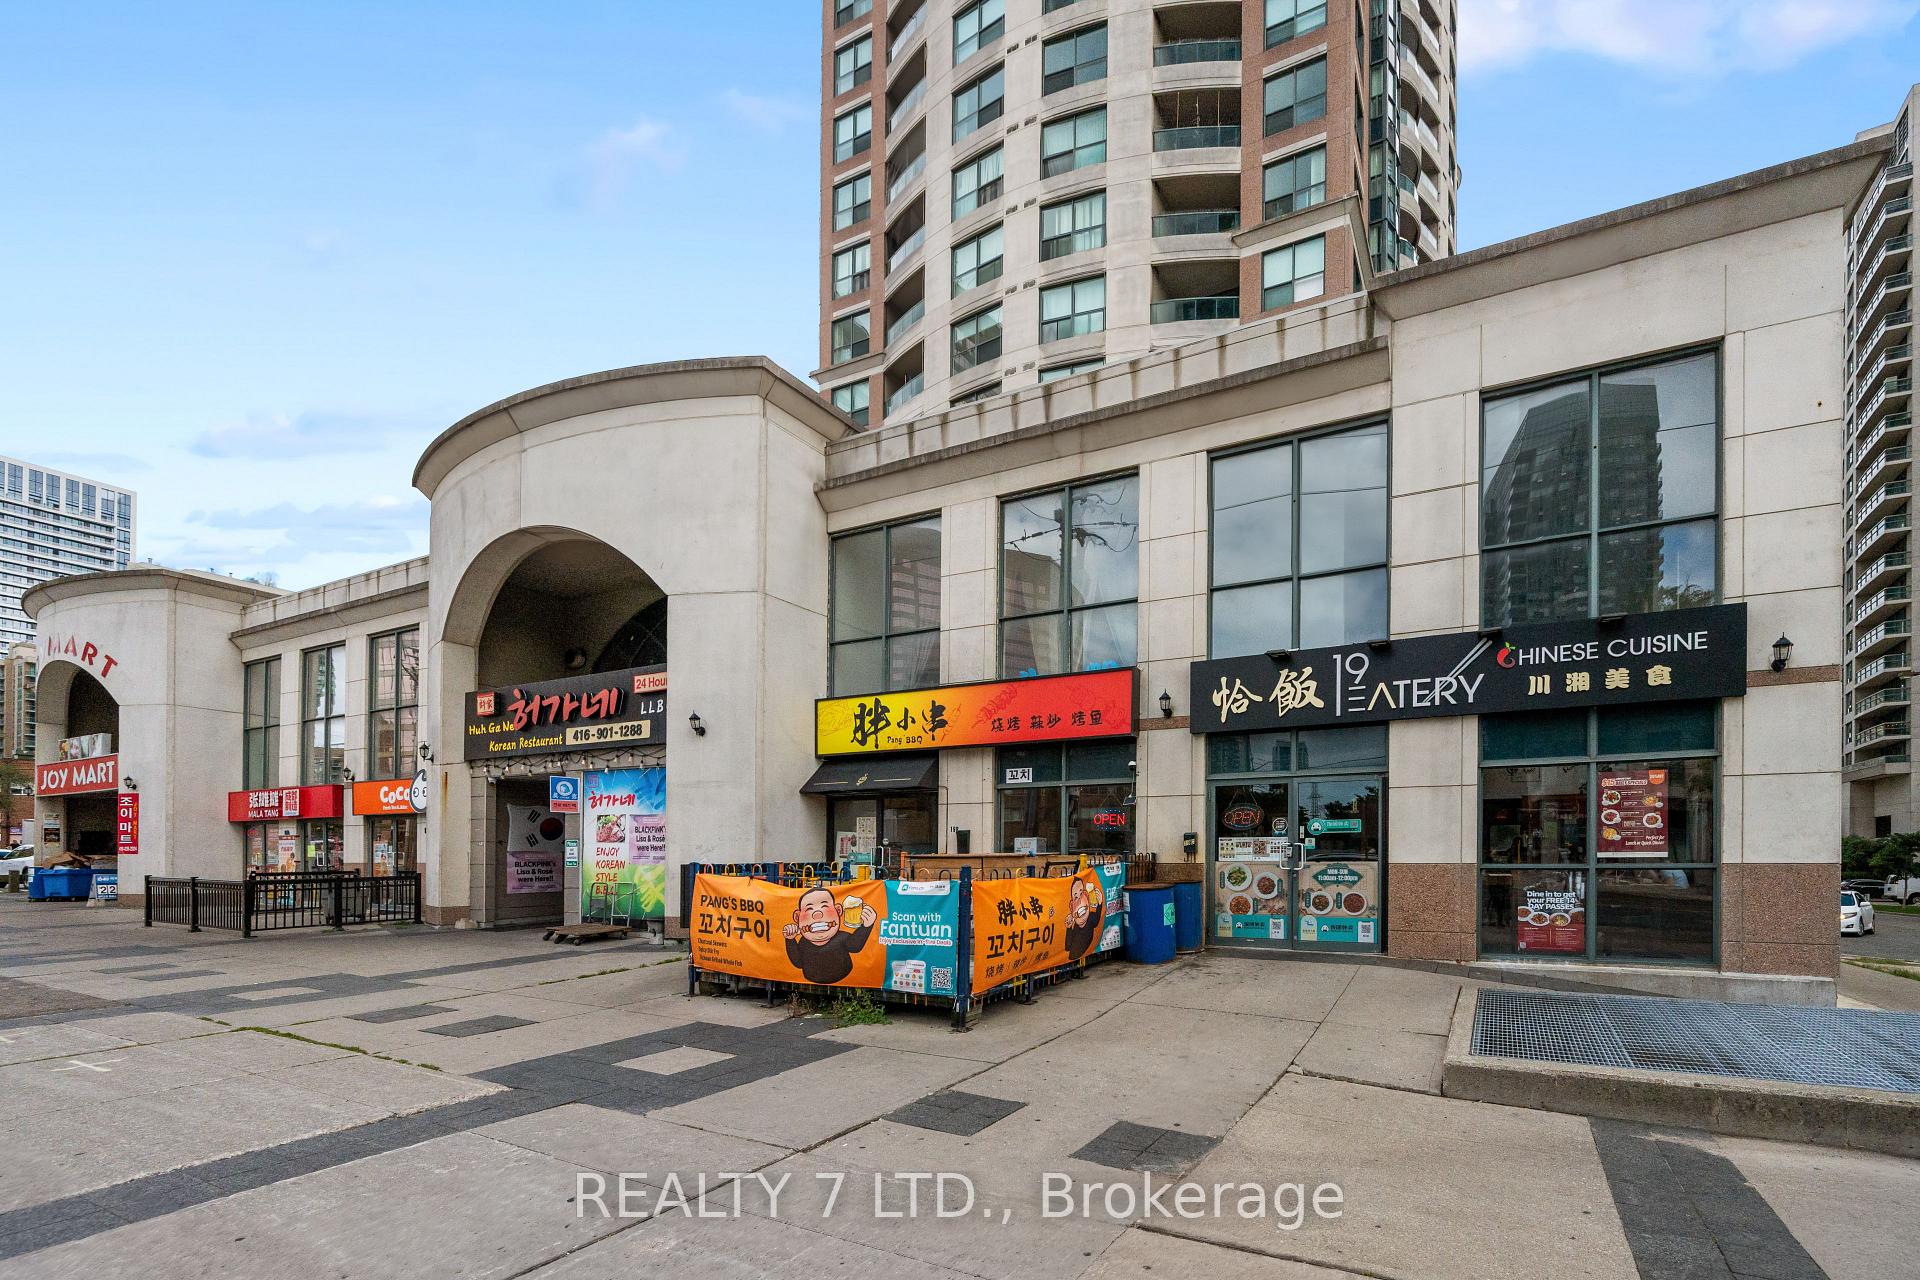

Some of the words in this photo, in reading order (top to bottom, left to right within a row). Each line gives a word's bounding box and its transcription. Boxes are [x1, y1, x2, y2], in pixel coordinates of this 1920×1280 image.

[1607, 631, 1708, 658] CUISINE
[636, 679, 646, 689] 24
[1528, 664, 1672, 696] 川湘美食
[1212, 666, 1325, 724] 恰飯
[506, 688, 619, 731] 허가네
[468, 724, 487, 735] Huh
[488, 722, 501, 733] Ga
[502, 720, 515, 732] Ne
[850, 697, 948, 750] 胖小串
[572, 724, 643, 742] 416-901-1288
[906, 735, 922, 744] BBQ
[489, 740, 517, 752] Korean
[519, 733, 563, 749] Restaurant
[40, 767, 68, 790] JOY
[72, 761, 115, 786] MART
[1008, 768, 1031, 781] 꼬치
[588, 791, 636, 810] 허가네
[119, 796, 133, 844] 조이마트
[1093, 814, 1126, 825] OPEN
[1224, 810, 1261, 825] OPEN
[636, 835, 647, 843] Lisa
[647, 835, 651, 843] &
[637, 844, 650, 852] were
[596, 847, 620, 856] ENJOY
[595, 860, 625, 870] KOREAN
[595, 873, 618, 883] STYLE
[700, 894, 737, 910] PANG'S
[739, 898, 764, 915] BBQ
[1527, 897, 1545, 905] your
[1562, 892, 1576, 900] get
[892, 912, 916, 921] Scan
[919, 912, 941, 922] with
[996, 896, 1044, 927] 胖小串
[698, 913, 770, 942] 꼬치구이
[880, 920, 952, 938] Fantuan
[986, 923, 1055, 959] 꼬치구이
